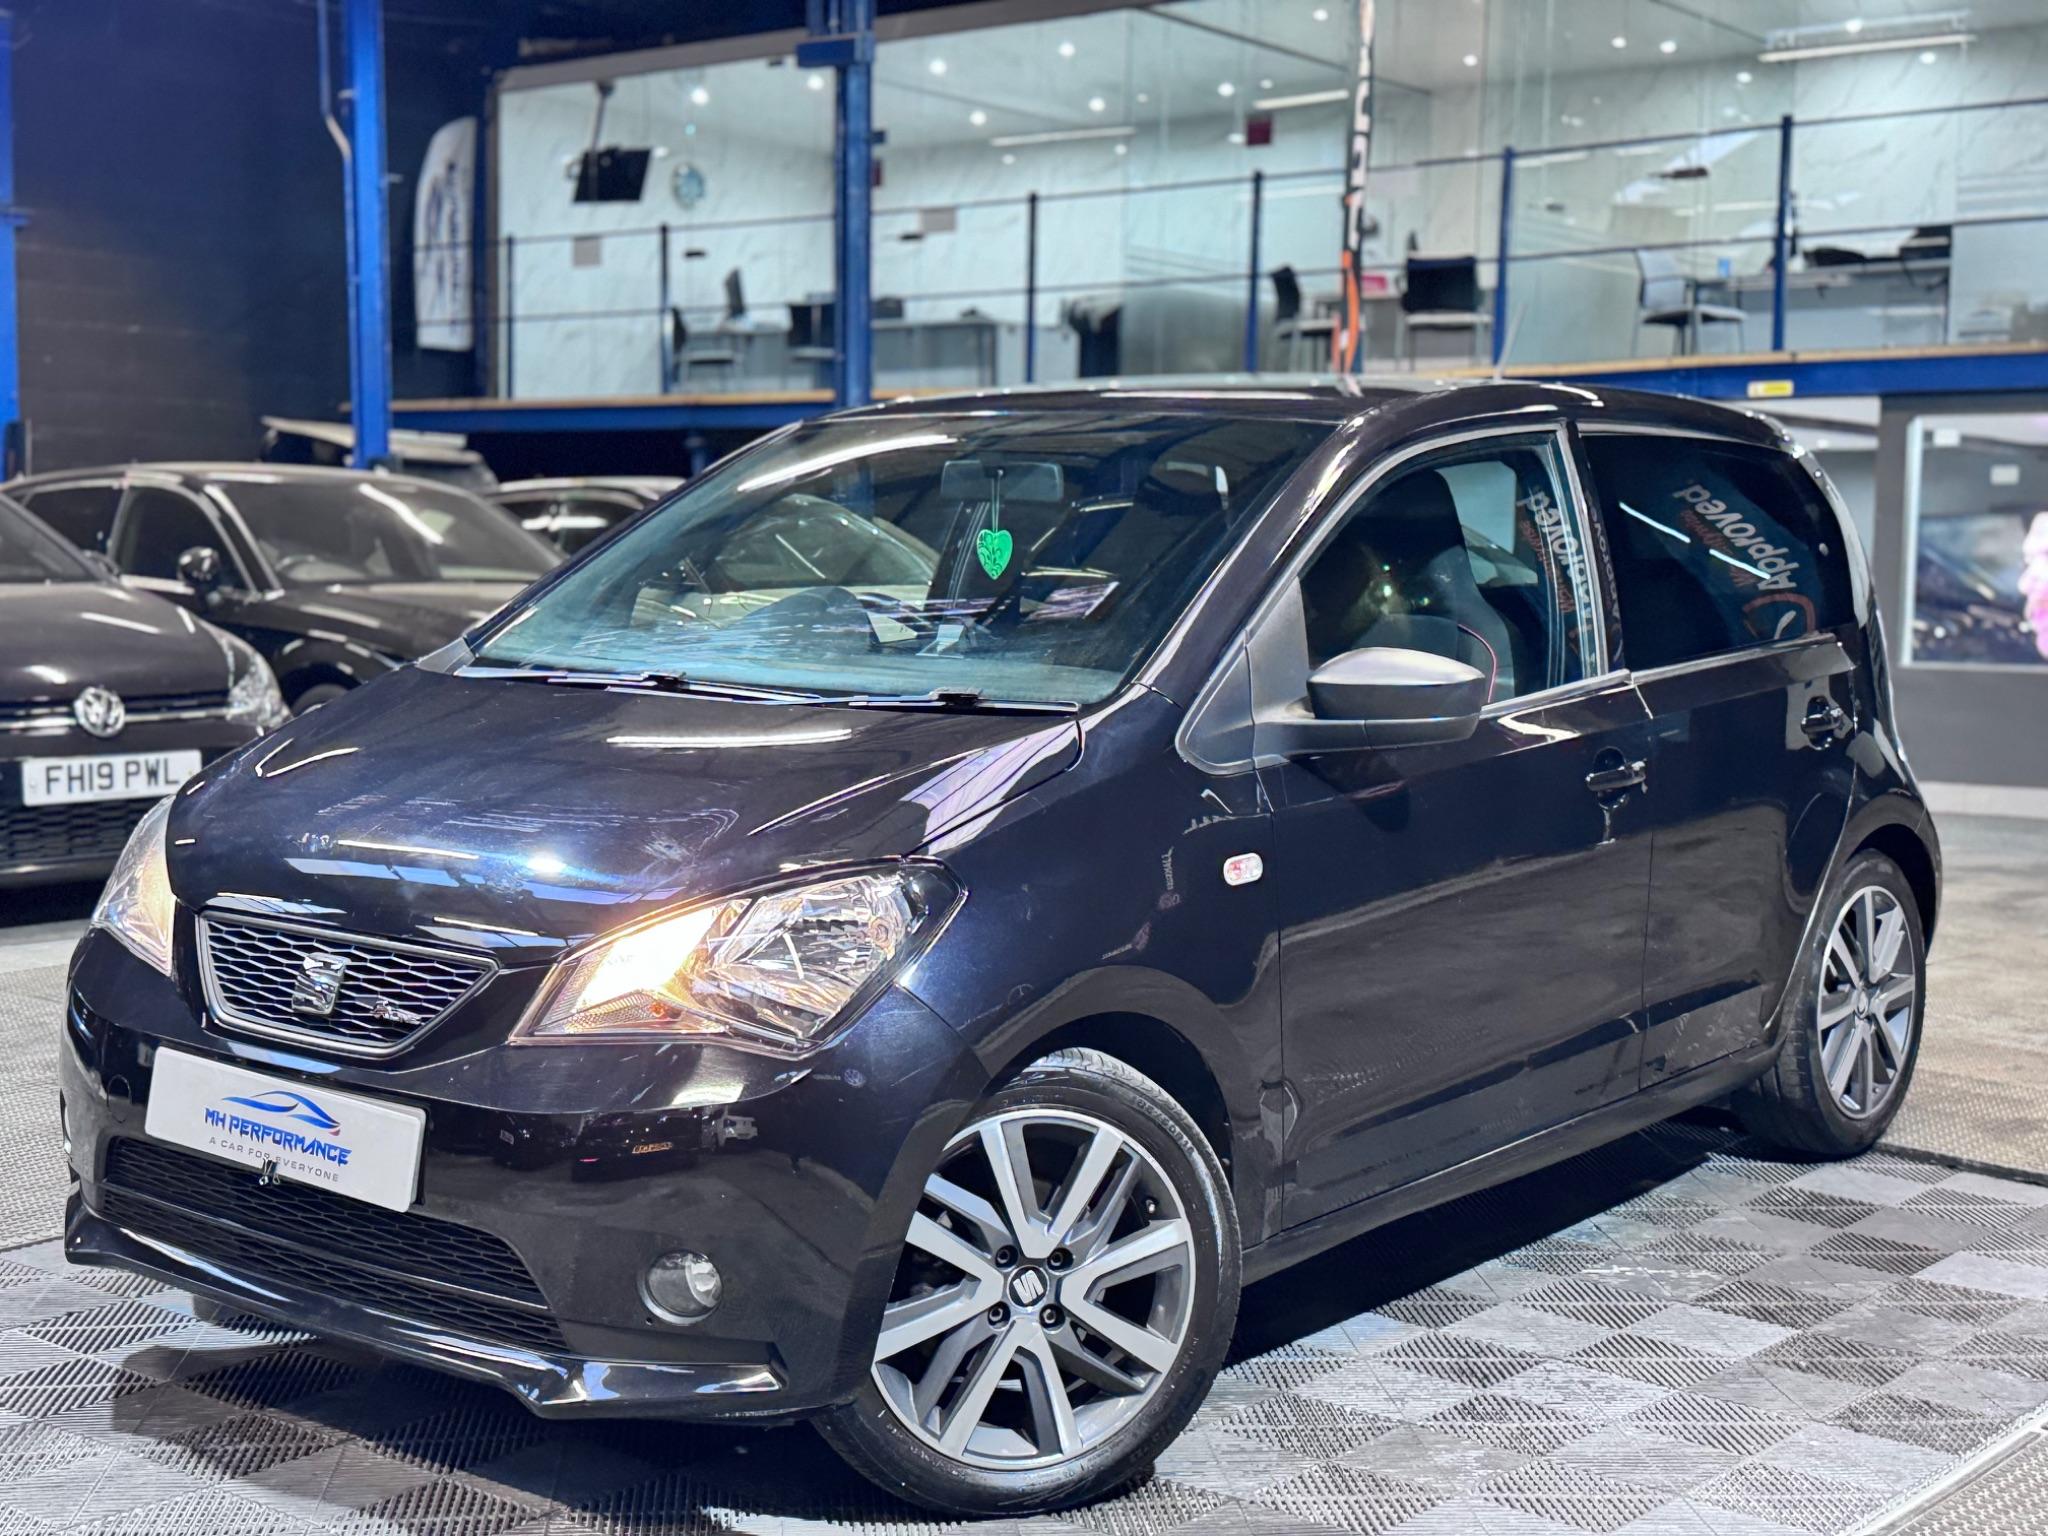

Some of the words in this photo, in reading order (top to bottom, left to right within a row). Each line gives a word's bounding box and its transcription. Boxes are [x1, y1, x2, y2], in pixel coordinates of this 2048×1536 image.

[1672, 484, 1800, 591] Approved
[45, 760, 114, 795] FH19
[125, 758, 180, 789] PWL
[205, 1107, 227, 1130] MH
[229, 1114, 353, 1167] PERFORMANCE
[209, 1137, 216, 1145] A
[221, 1140, 243, 1153] CAR
[249, 1148, 270, 1160] FOR
[276, 1156, 339, 1182] EVERYONE
